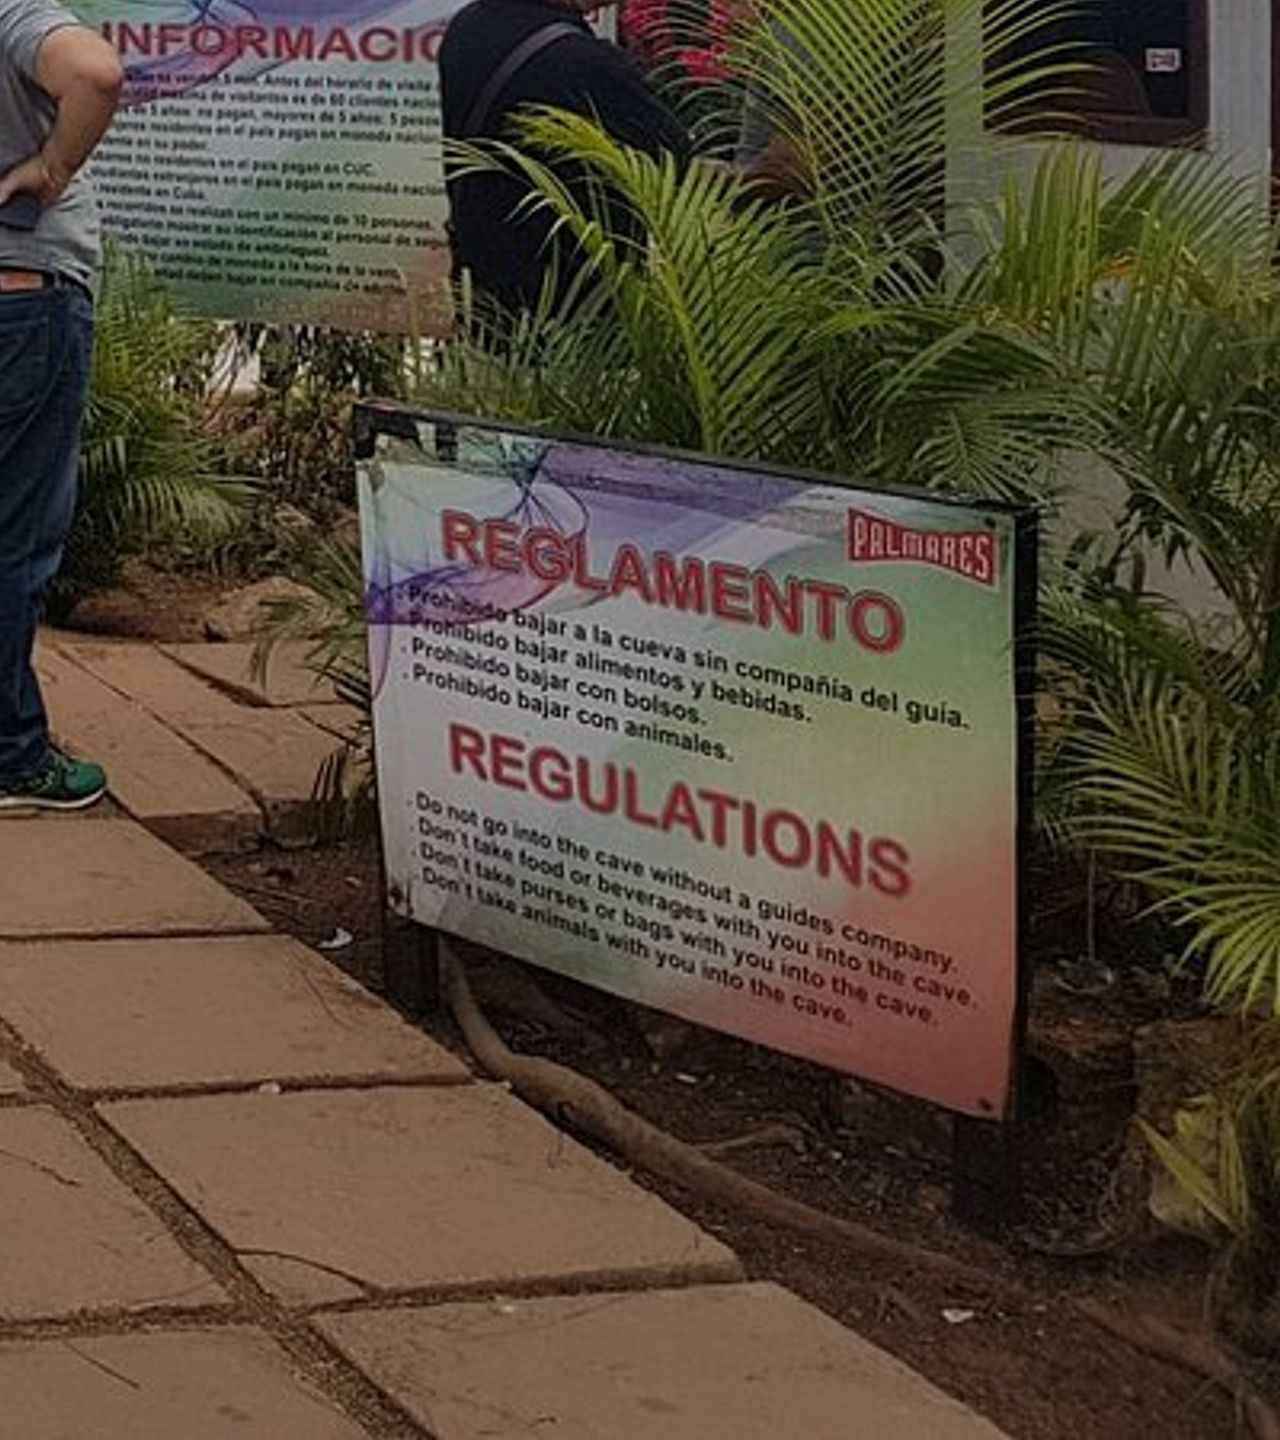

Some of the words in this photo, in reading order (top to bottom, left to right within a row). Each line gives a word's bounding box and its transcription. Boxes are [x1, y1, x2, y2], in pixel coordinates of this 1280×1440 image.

[198, 108, 212, 119] no
[263, 110, 315, 124] mayores
[320, 110, 334, 122] de
[339, 111, 346, 123] 5
[391, 112, 398, 125] 5
[211, 91, 225, 103] de
[311, 94, 326, 107] de
[349, 96, 398, 108] clientes
[265, 76, 299, 87] Antes
[304, 76, 324, 88] del
[326, 77, 373, 91] horario
[378, 79, 391, 91] de
[397, 79, 431, 93] visita
[151, 121, 213, 135] residentes
[216, 123, 230, 135] en
[234, 123, 245, 135] el
[278, 127, 318, 142] pagan
[340, 129, 392, 142] moneda
[154, 154, 216, 168] residentes
[220, 158, 235, 168] en
[281, 162, 321, 175] pagan
[324, 163, 339, 174] en
[186, 204, 234, 217] realizan
[264, 210, 280, 221] un
[333, 213, 350, 225] de
[223, 174, 237, 185] en
[285, 178, 324, 193] pagan
[328, 181, 342, 191] en
[347, 181, 398, 195] moneda
[304, 261, 331, 274] hora
[336, 263, 350, 275] de
[336, 230, 392, 245] personal
[396, 234, 411, 246] de
[442, 508, 906, 654] REGLAMENTO
[852, 510, 990, 580] PALMARES
[408, 584, 507, 624] Prohibido
[512, 608, 567, 637] bajar
[573, 624, 587, 641] a
[592, 624, 612, 647] la
[618, 634, 686, 662] cueva
[693, 648, 728, 674] sin
[734, 658, 853, 703] compañía
[860, 686, 899, 713] del
[408, 611, 509, 651] Prohibido
[515, 635, 568, 664] bajar
[575, 650, 685, 692] alimentos
[690, 680, 705, 701] y
[711, 681, 813, 723] bebidas.
[411, 636, 511, 679] Prohibido
[515, 661, 570, 692] bajar
[576, 681, 617, 705] con
[624, 686, 707, 726] bolsos.
[411, 663, 512, 706] Prohibido
[517, 689, 571, 720] bajar
[576, 709, 619, 732] con
[624, 718, 734, 762] animales.
[449, 721, 912, 898] REGULATIONS
[416, 790, 442, 815] Do
[446, 801, 479, 827] not
[483, 817, 508, 839] go
[512, 820, 552, 850] into
[557, 833, 590, 862] the
[595, 850, 645, 877] cave
[651, 866, 732, 905] without
[738, 892, 751, 911] a
[758, 897, 835, 937] guides
[841, 922, 960, 976] company.
[473, 834, 514, 863] take
[518, 850, 565, 880] food
[570, 868, 592, 888] or
[597, 872, 707, 924] beverages
[714, 909, 760, 942] with
[767, 928, 809, 956] you
[816, 939, 862, 972] into
[868, 956, 906, 986] the
[912, 973, 979, 1010] cave.
[475, 860, 516, 888] take
[520, 878, 589, 913] purses
[594, 902, 617, 923] or
[623, 907, 674, 943] bags
[680, 926, 727, 958] with
[733, 947, 774, 973] you
[780, 957, 826, 988] into
[831, 974, 869, 1004] the
[875, 992, 940, 1027] cave.
[477, 884, 518, 915] take
[521, 903, 600, 943] animals
[605, 928, 651, 960] with
[655, 950, 696, 975] you
[700, 960, 744, 991] into
[749, 976, 786, 1005] the
[792, 992, 854, 1028] cave.
